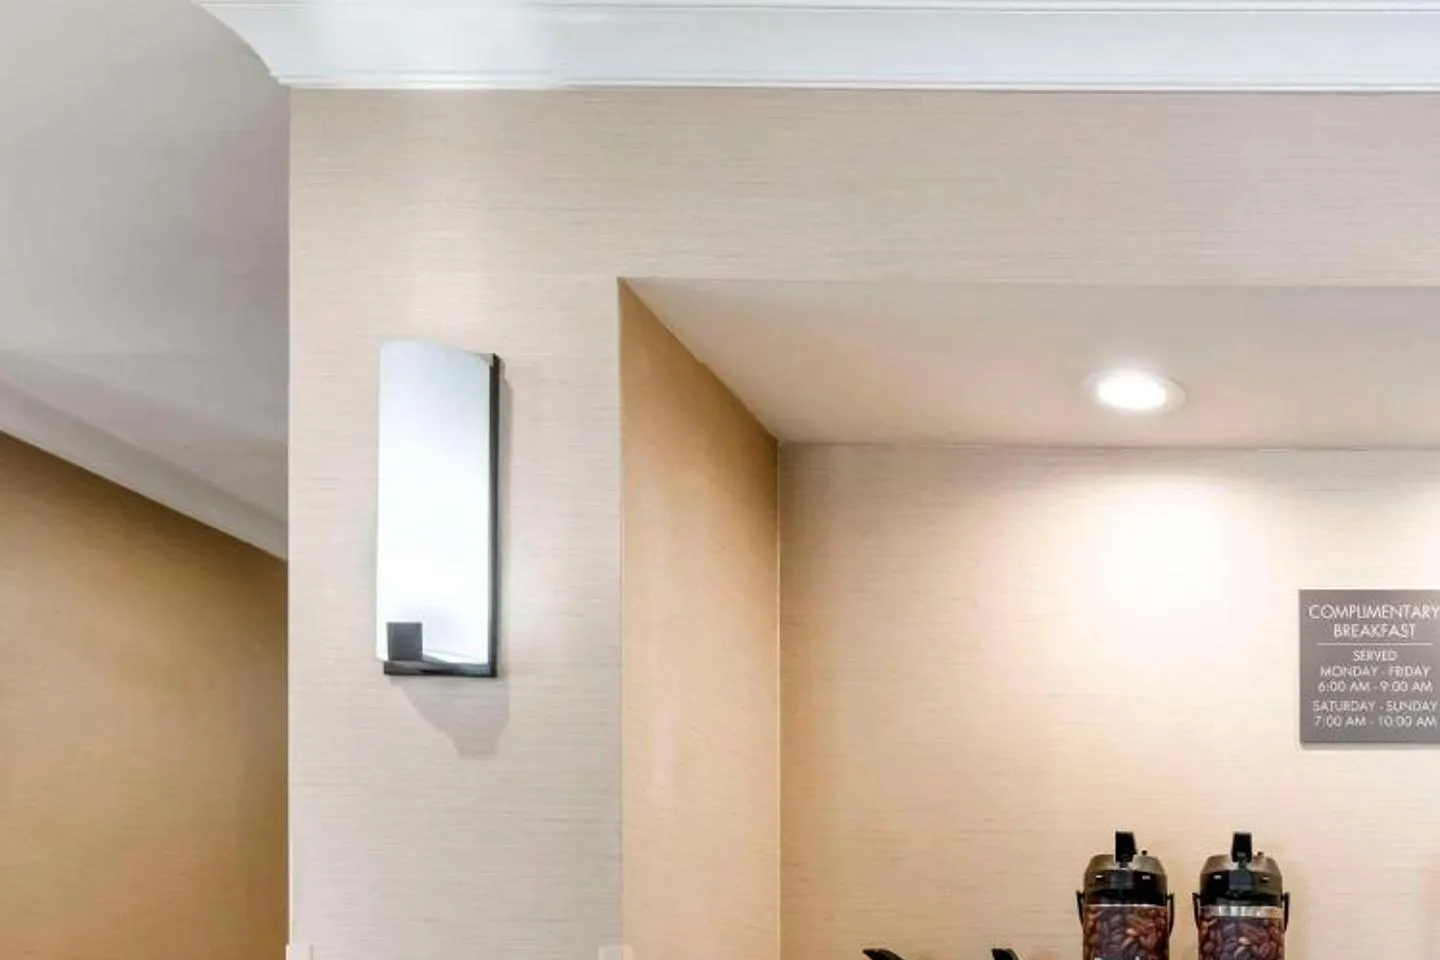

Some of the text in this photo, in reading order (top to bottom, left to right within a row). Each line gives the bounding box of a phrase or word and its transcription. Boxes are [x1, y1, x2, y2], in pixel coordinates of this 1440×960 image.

[1308, 604, 1440, 619] COMPLIMENTARY
[1333, 623, 1416, 638] BREAKFAST
[1352, 650, 1398, 662] SERVED
[1320, 665, 1378, 677] MONDAY
[1388, 665, 1431, 677] FRIDAY
[1318, 681, 1345, 692] 6:00
[1350, 681, 1371, 692] AM
[1380, 681, 1408, 692] 9:00
[1411, 681, 1433, 692] AM
[1312, 701, 1376, 712] SATURDAY
[1386, 701, 1438, 712] SUNDAY
[1314, 716, 1342, 727] 7:00
[1345, 716, 1366, 727] AM
[1415, 716, 1438, 727] AM
